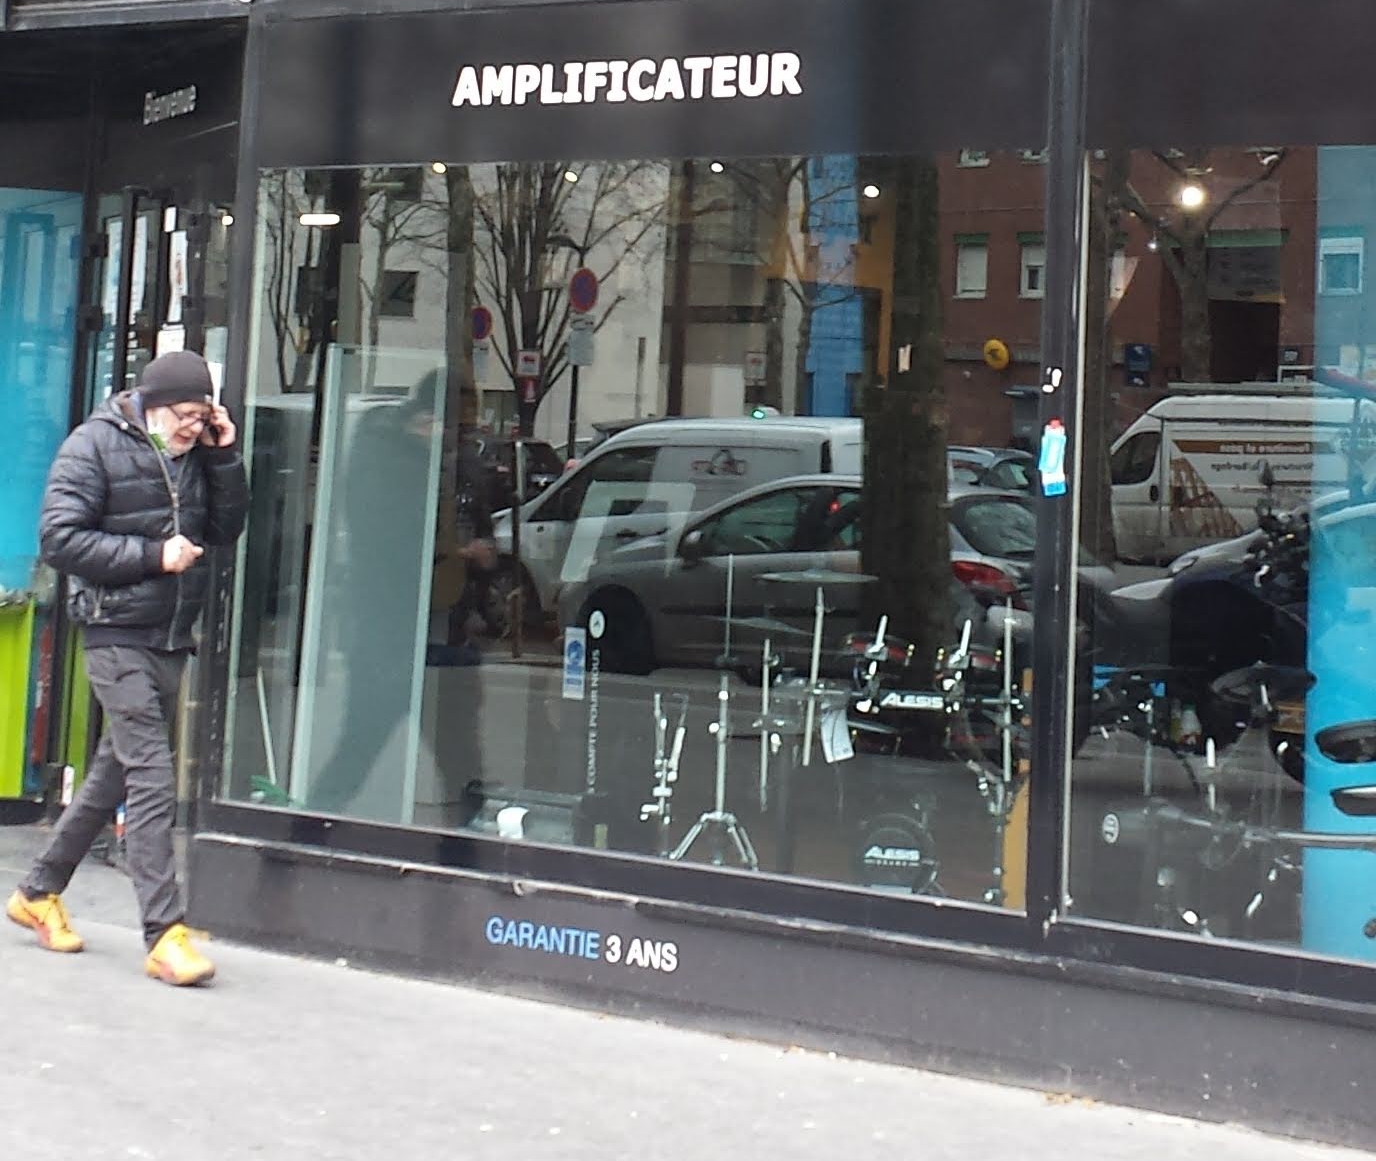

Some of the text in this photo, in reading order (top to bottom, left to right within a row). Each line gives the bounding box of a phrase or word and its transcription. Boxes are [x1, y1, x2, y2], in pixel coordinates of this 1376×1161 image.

[451, 51, 804, 107] AMPLIFICATEUR
[590, 648, 601, 687] NOUS
[879, 692, 945, 710] ALESIS
[485, 916, 679, 972] GARANTIE 3 ANS
